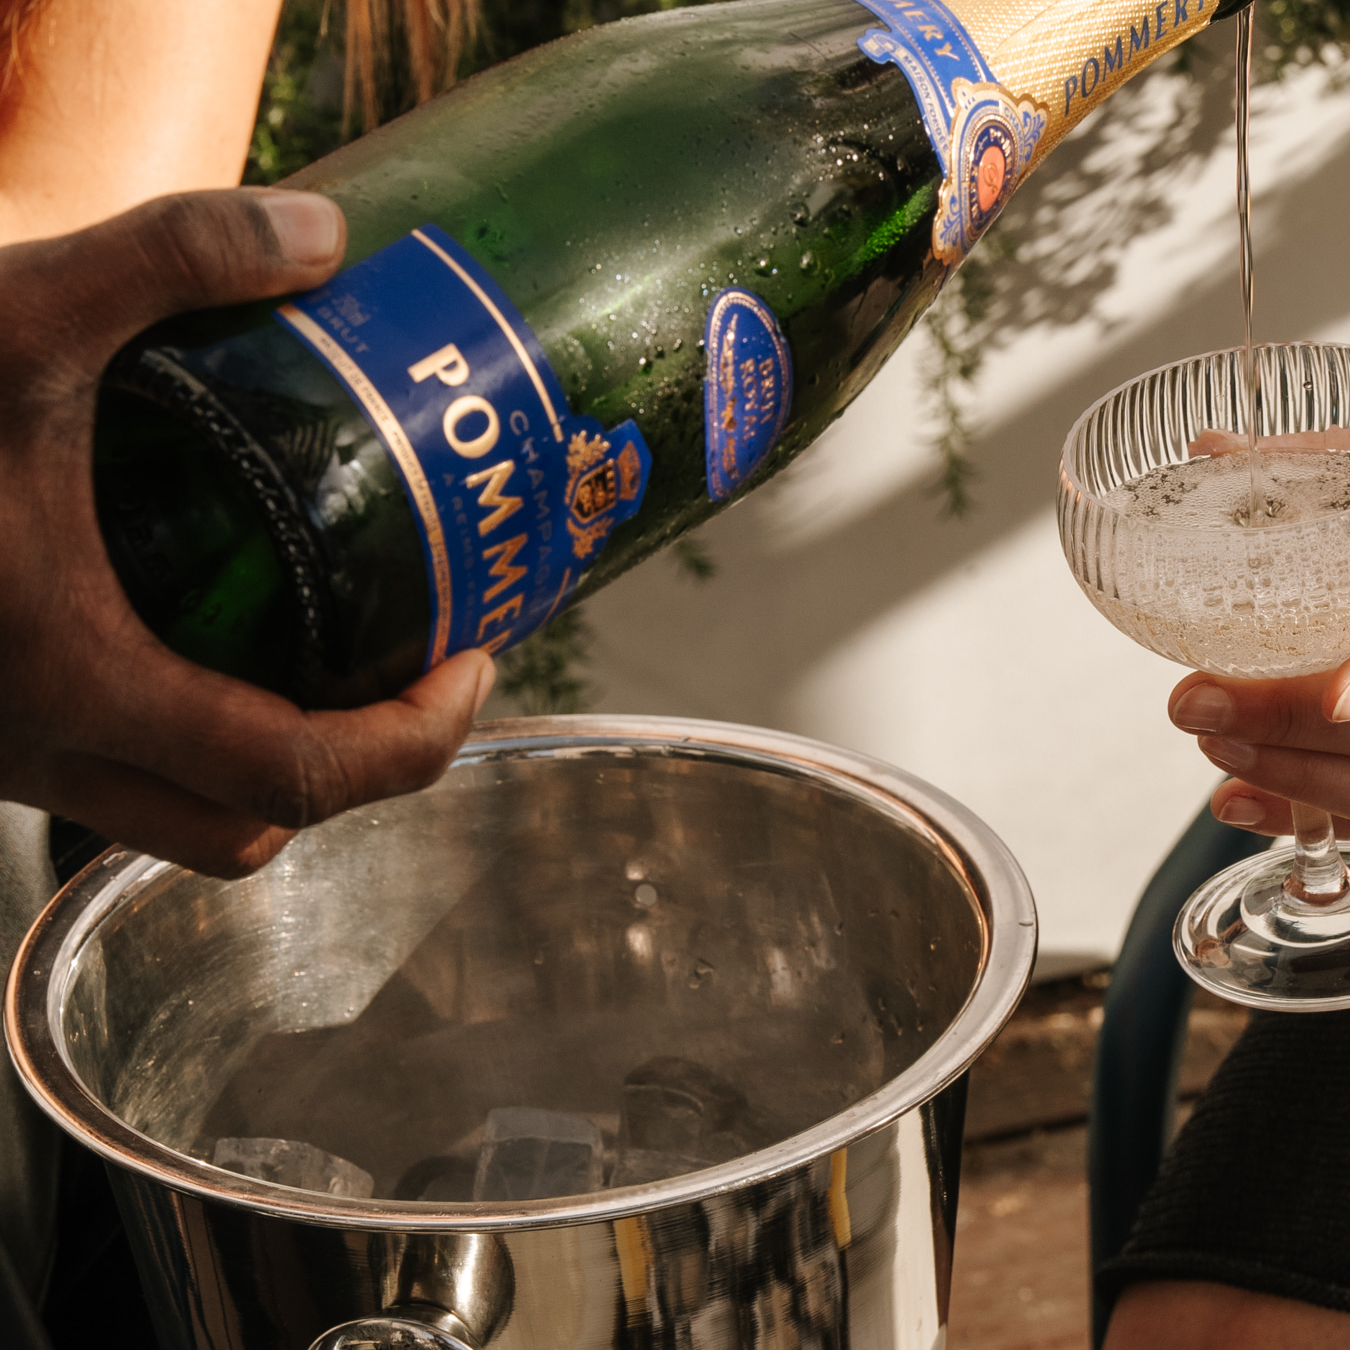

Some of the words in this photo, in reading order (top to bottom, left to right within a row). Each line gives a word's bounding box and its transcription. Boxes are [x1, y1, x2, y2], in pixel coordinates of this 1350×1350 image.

[903, 55, 932, 99] MAISON
[740, 358, 758, 446] ROYAL
[759, 357, 775, 424] BRUT
